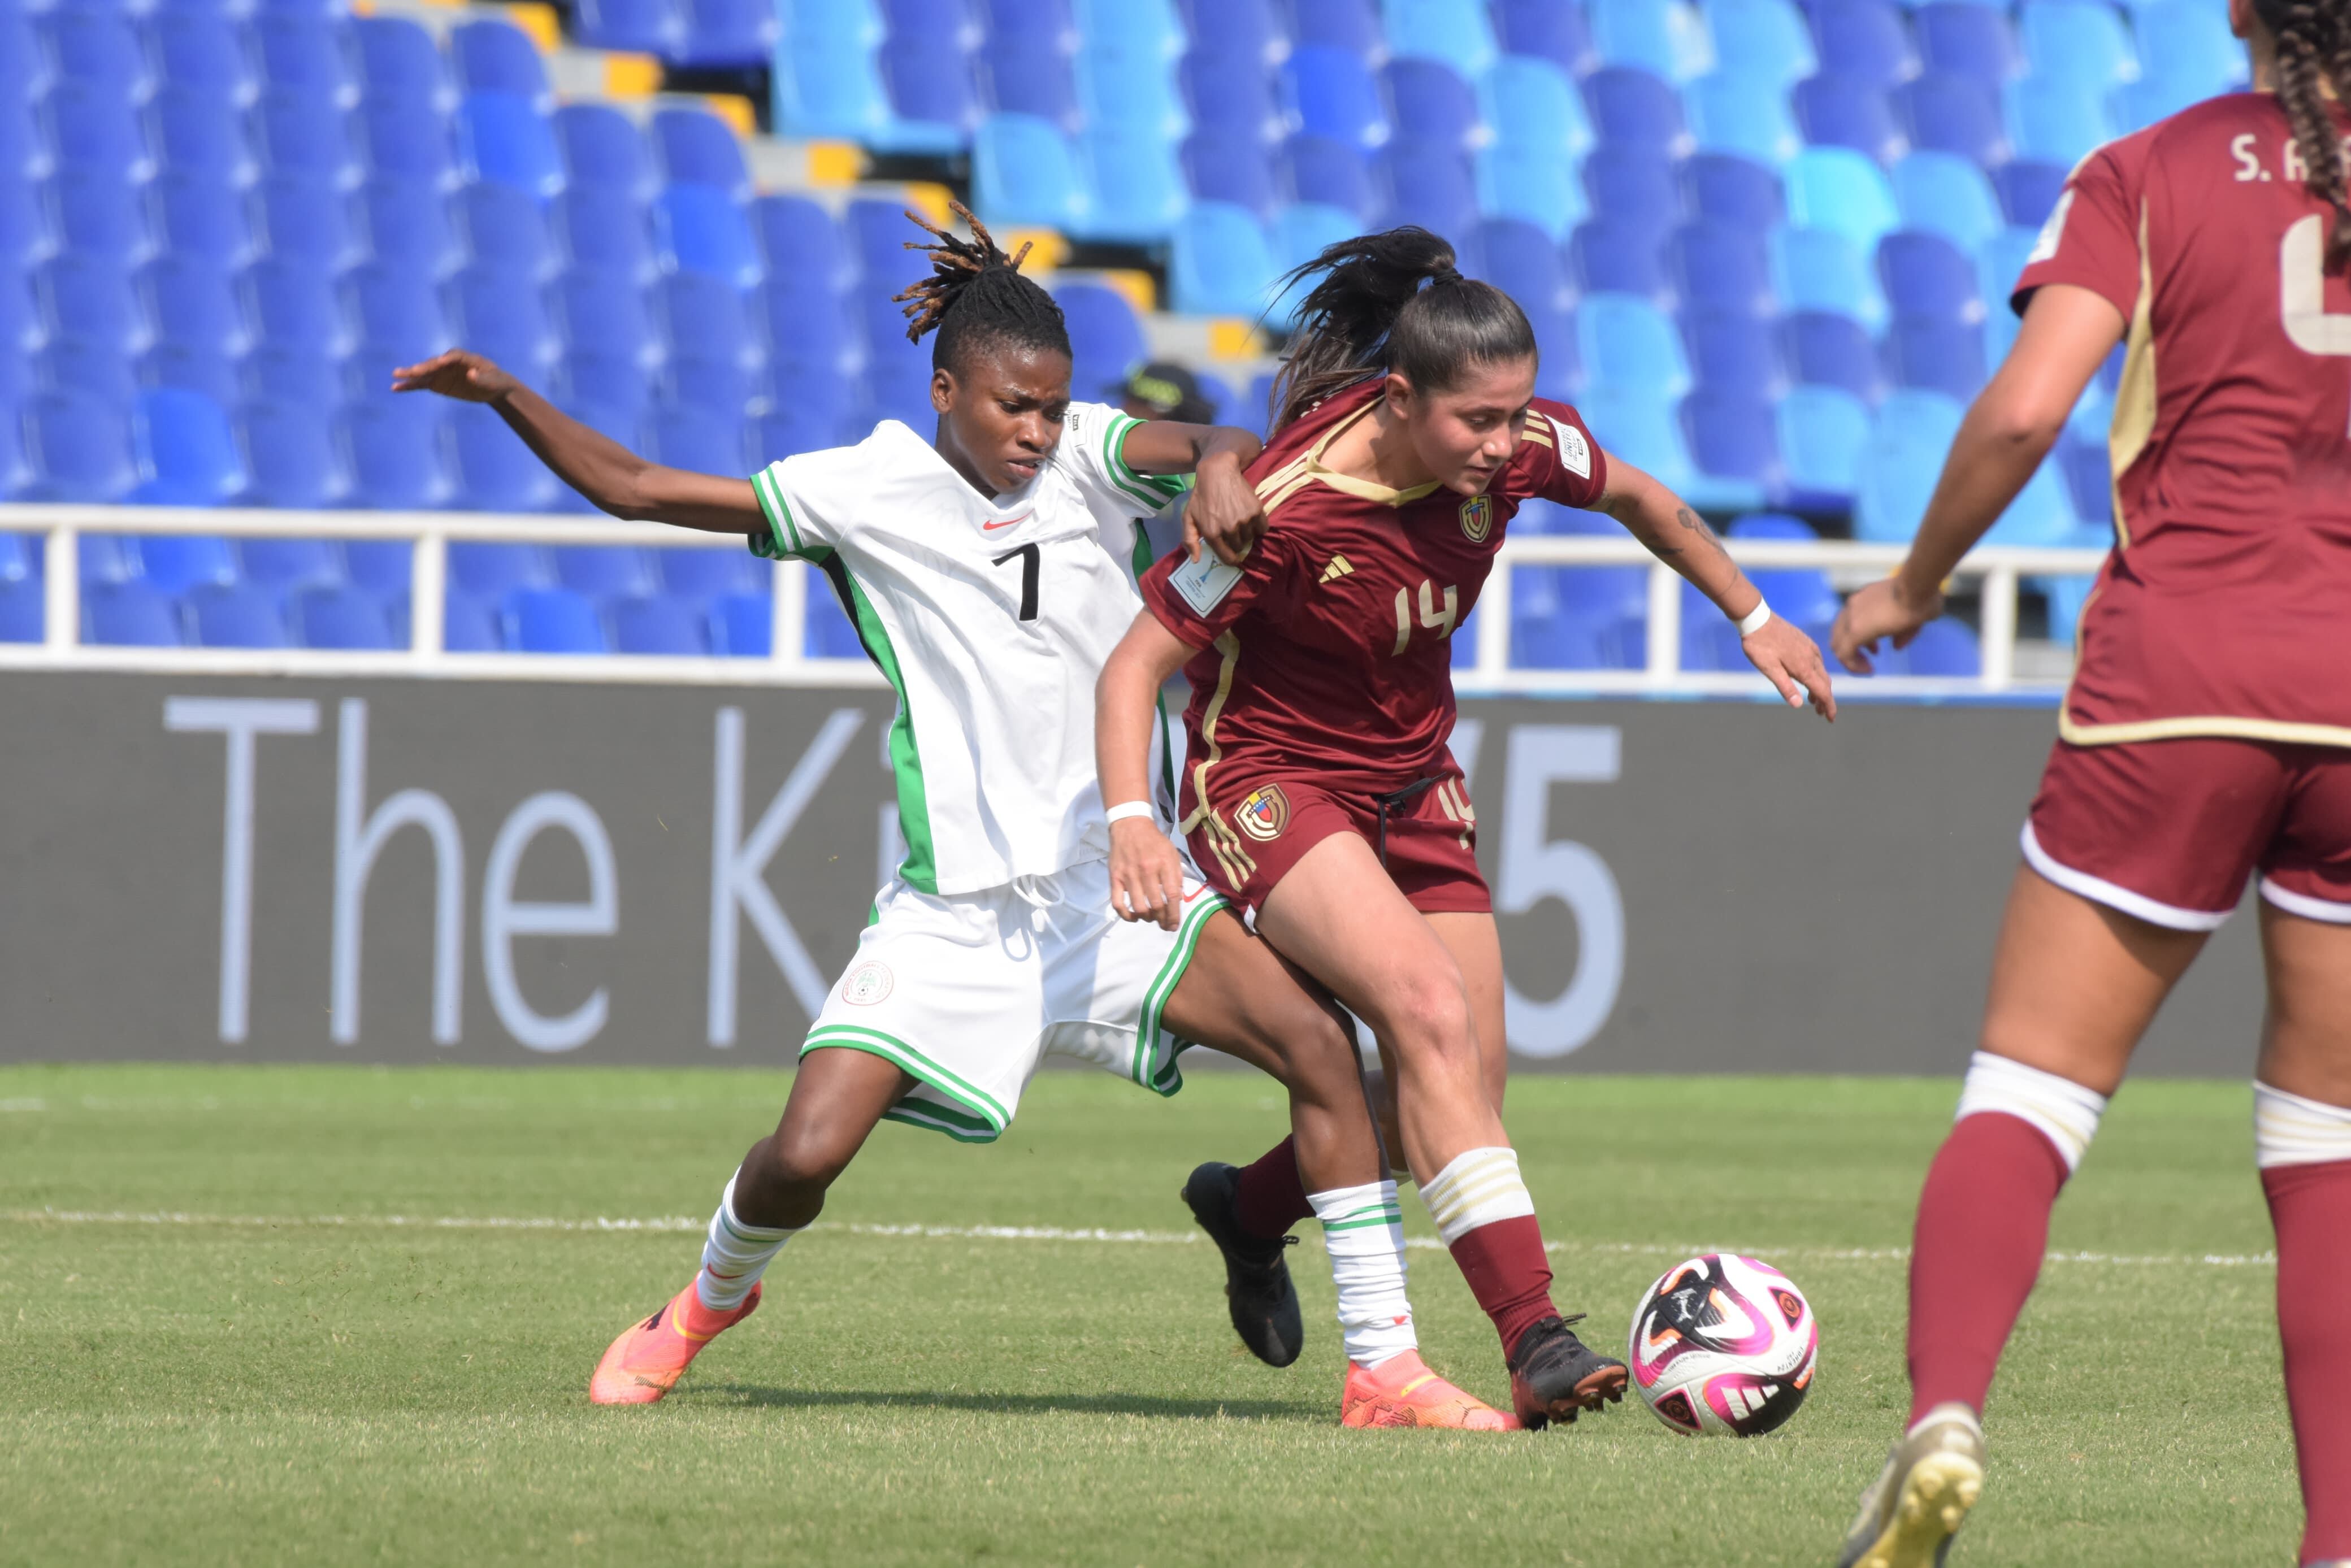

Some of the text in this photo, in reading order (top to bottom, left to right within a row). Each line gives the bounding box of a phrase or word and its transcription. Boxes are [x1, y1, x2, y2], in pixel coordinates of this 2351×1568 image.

[991, 542, 1040, 621] 7
[1391, 579, 1458, 657] 14
[163, 696, 619, 1052] The
[1451, 719, 1626, 1058] 5
